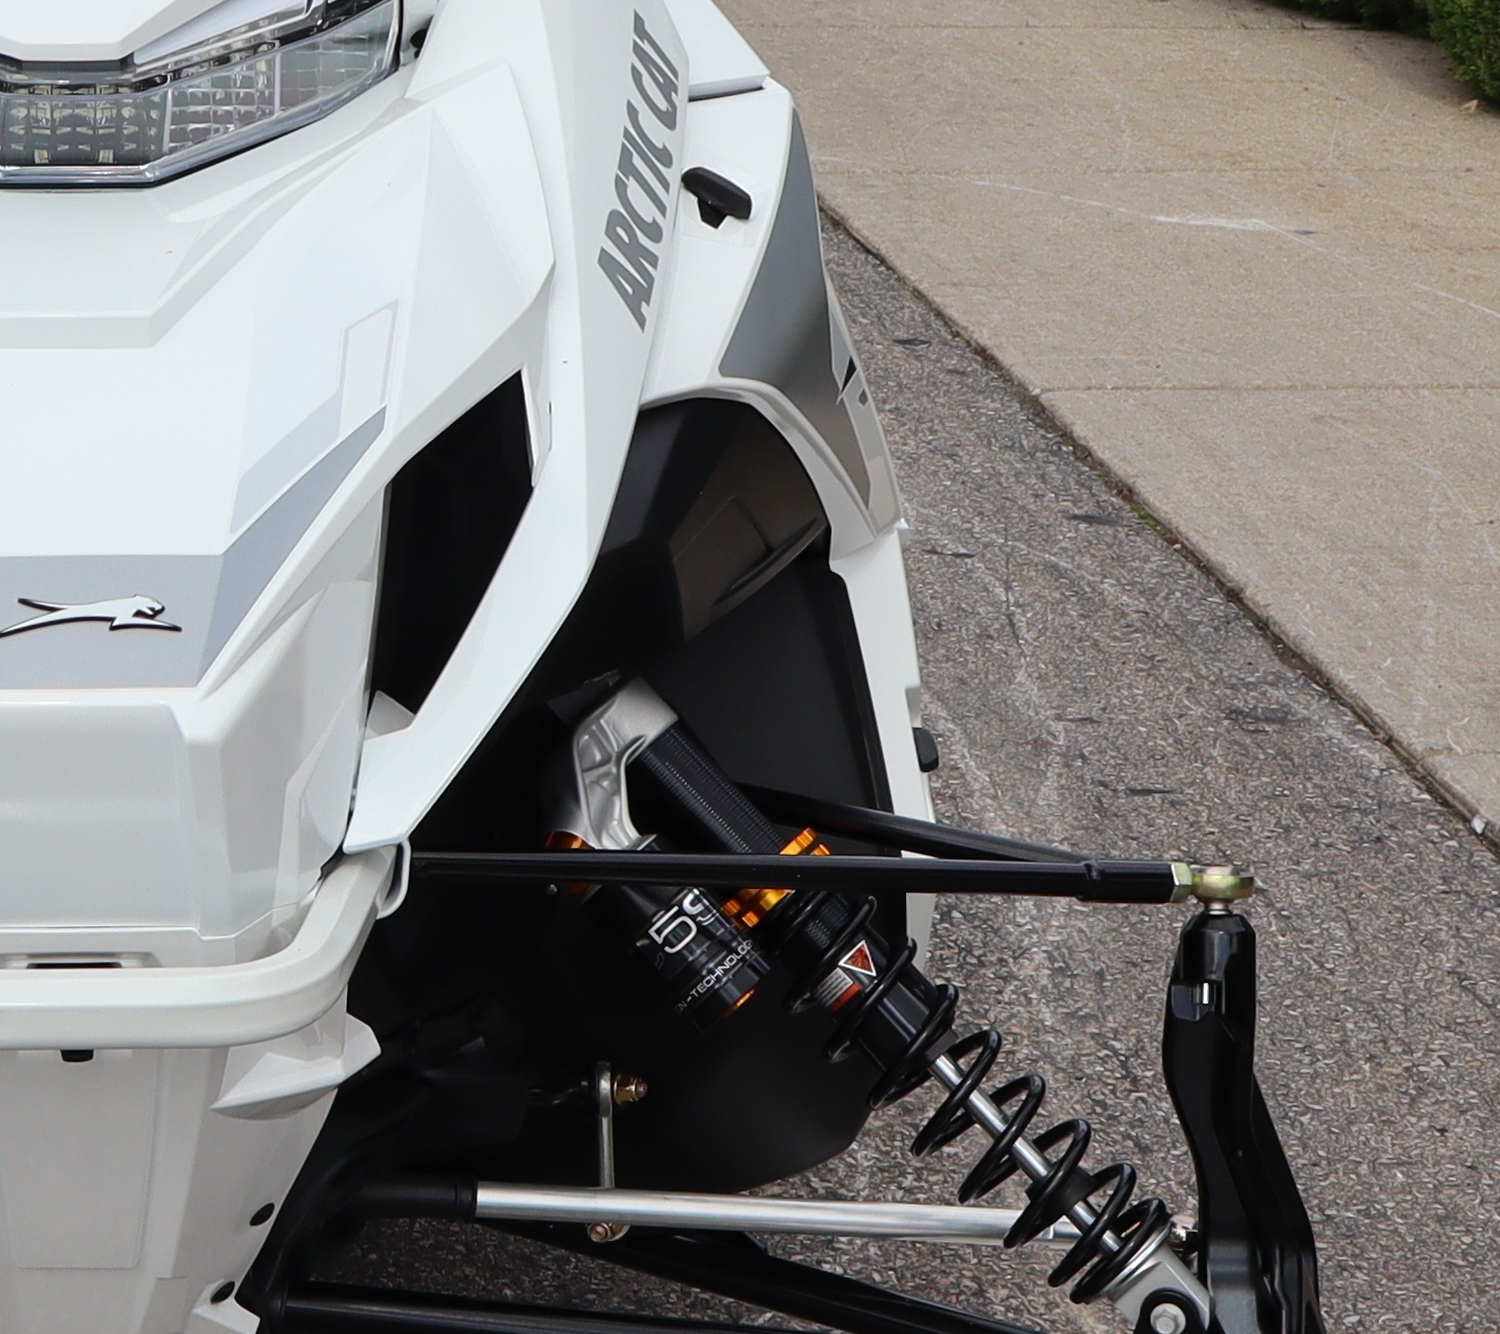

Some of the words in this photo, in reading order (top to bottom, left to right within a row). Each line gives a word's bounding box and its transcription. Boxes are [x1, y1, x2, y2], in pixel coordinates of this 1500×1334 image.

[630, 8, 680, 132] CAT
[597, 98, 674, 334] ARCTIC
[689, 939, 753, 998] TECHNOLOG
